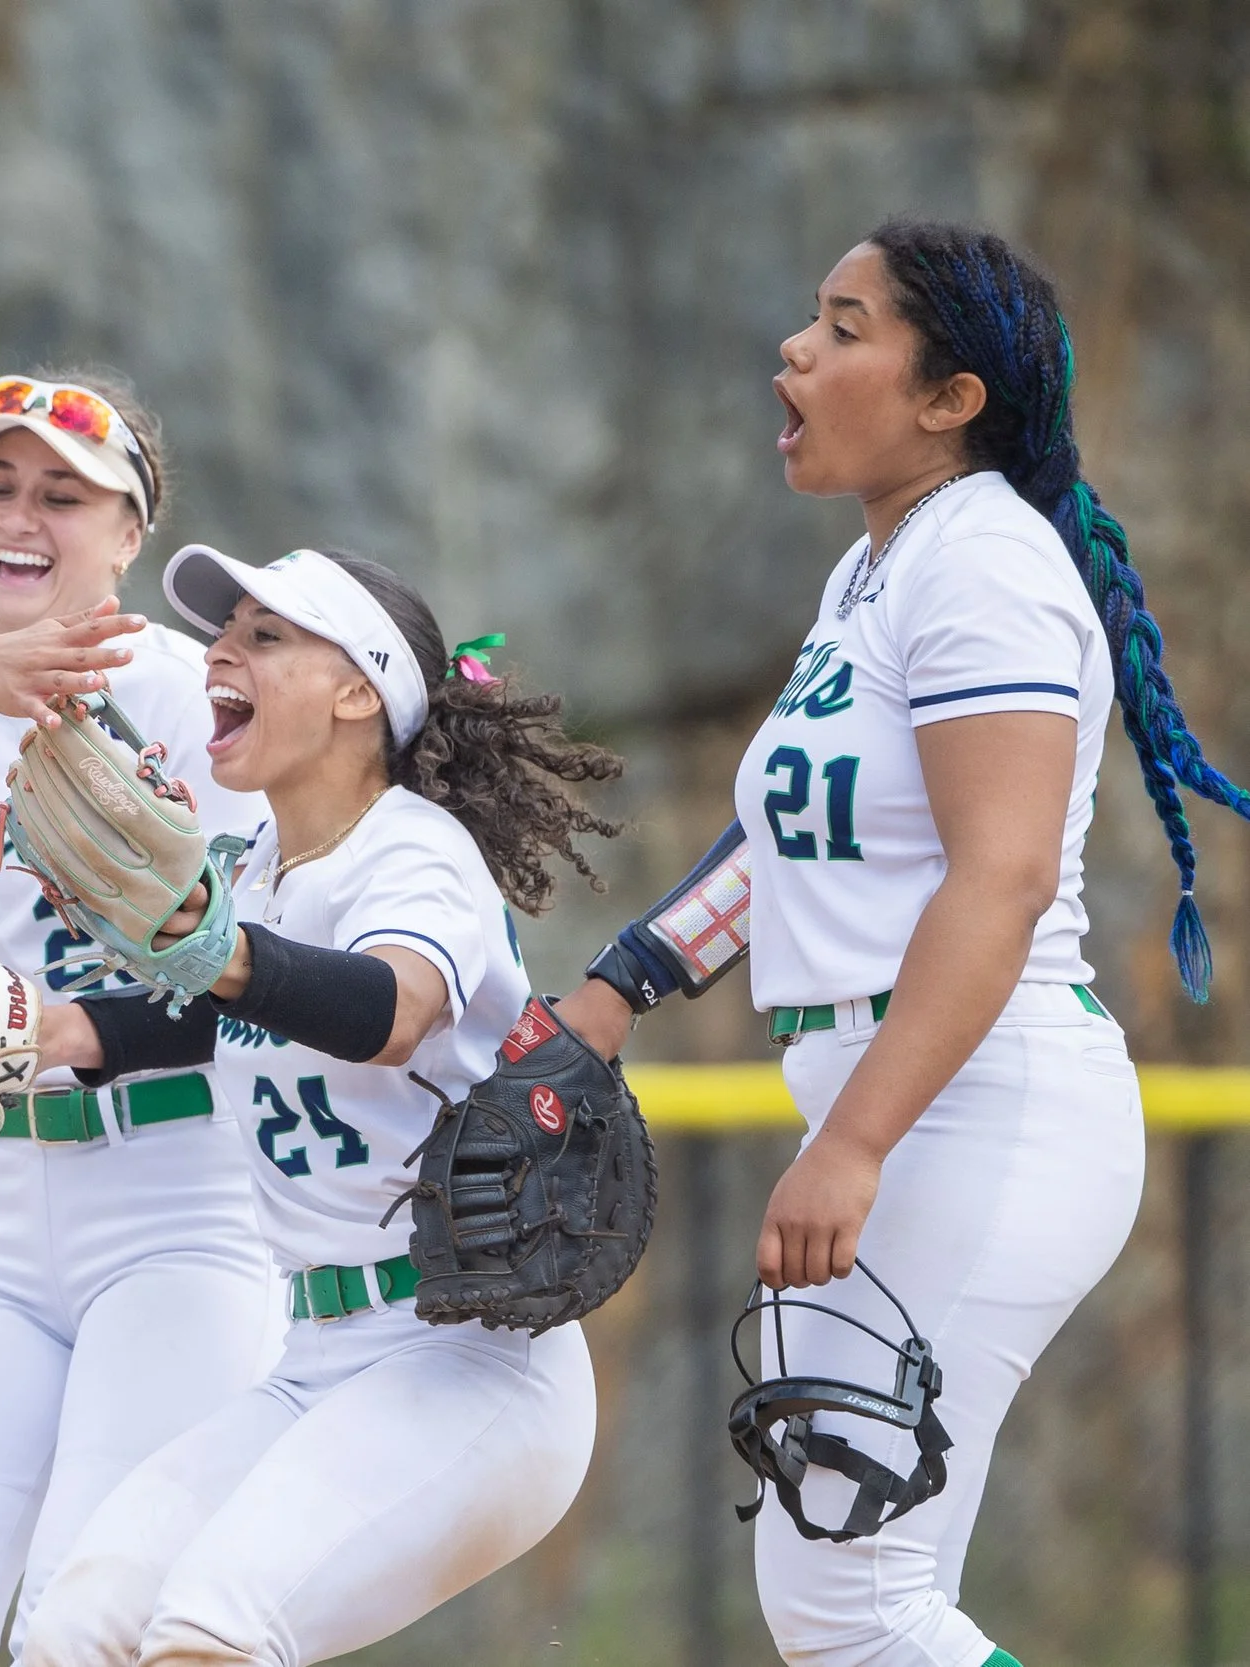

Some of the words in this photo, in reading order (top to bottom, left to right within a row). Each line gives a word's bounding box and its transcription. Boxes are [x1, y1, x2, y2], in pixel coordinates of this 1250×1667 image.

[79, 756, 140, 816] Rawlings
[763, 745, 865, 861] 21
[2, 965, 28, 1031] Wilso
[641, 979, 659, 1006] FCA
[252, 1074, 370, 1179] 24
[842, 1394, 885, 1413] RIP-IT
